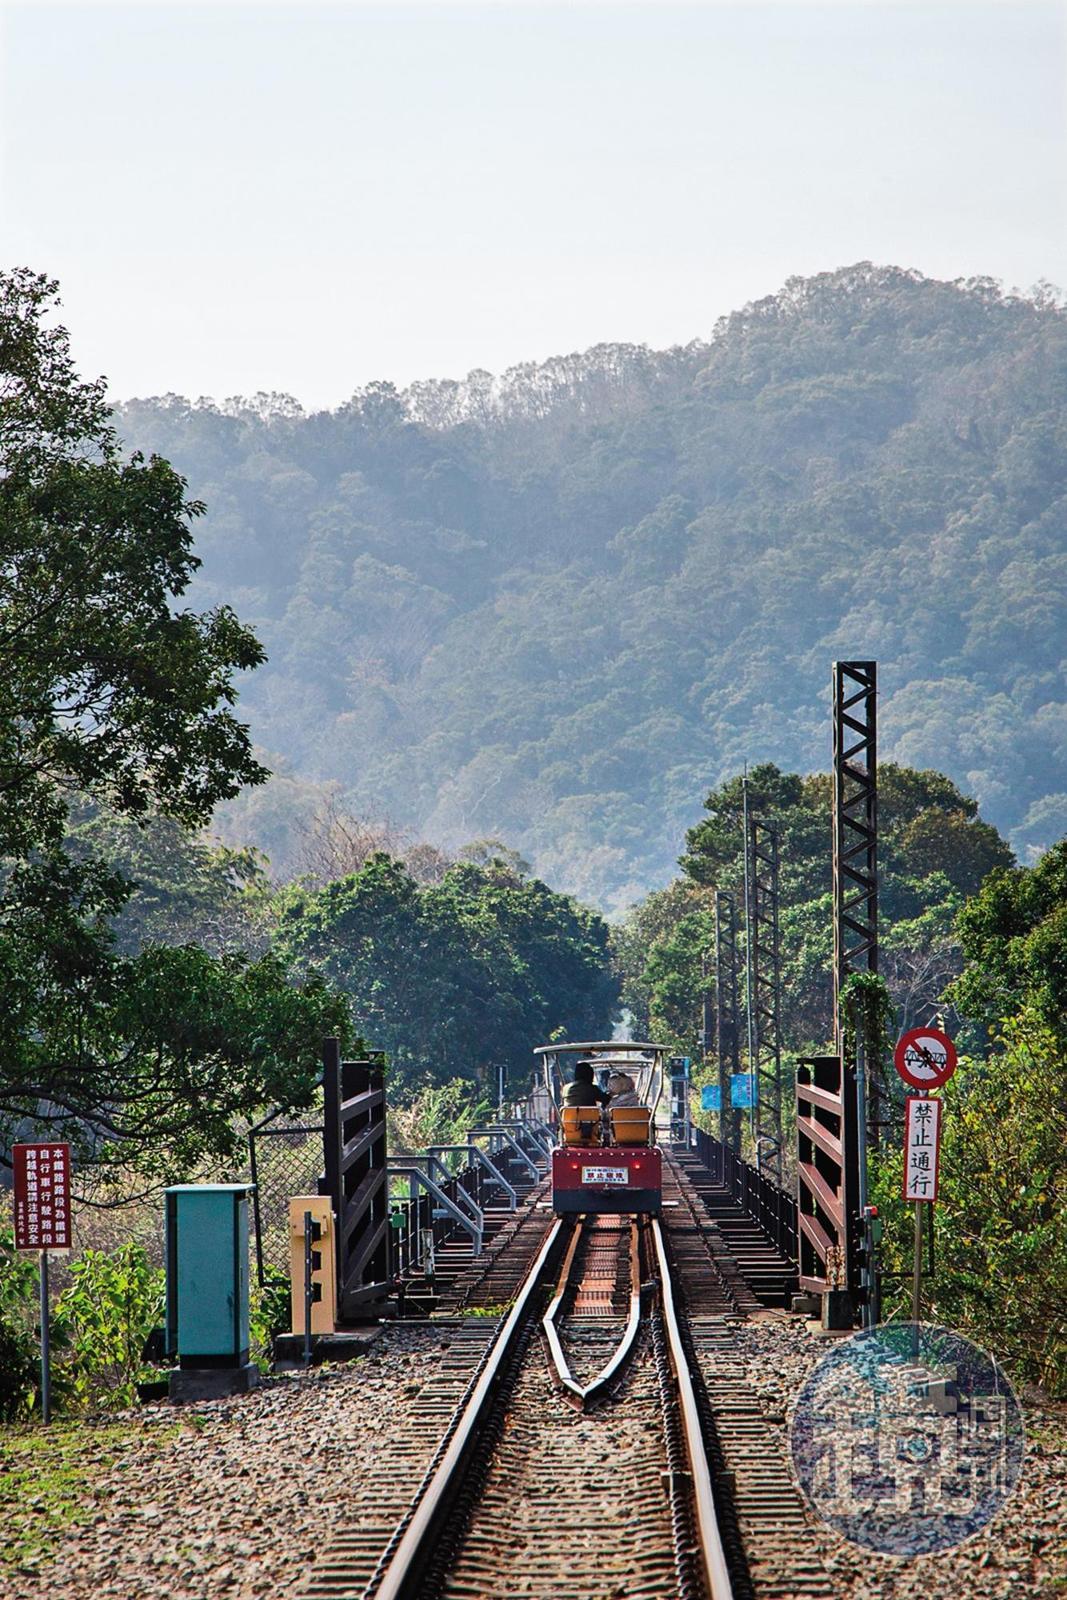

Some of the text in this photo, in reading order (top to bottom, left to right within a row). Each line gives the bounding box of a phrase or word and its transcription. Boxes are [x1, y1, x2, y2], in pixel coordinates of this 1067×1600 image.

[910, 1103, 933, 1195] 禁止通行
[40, 1149, 52, 1244] 自行車行駛路段
